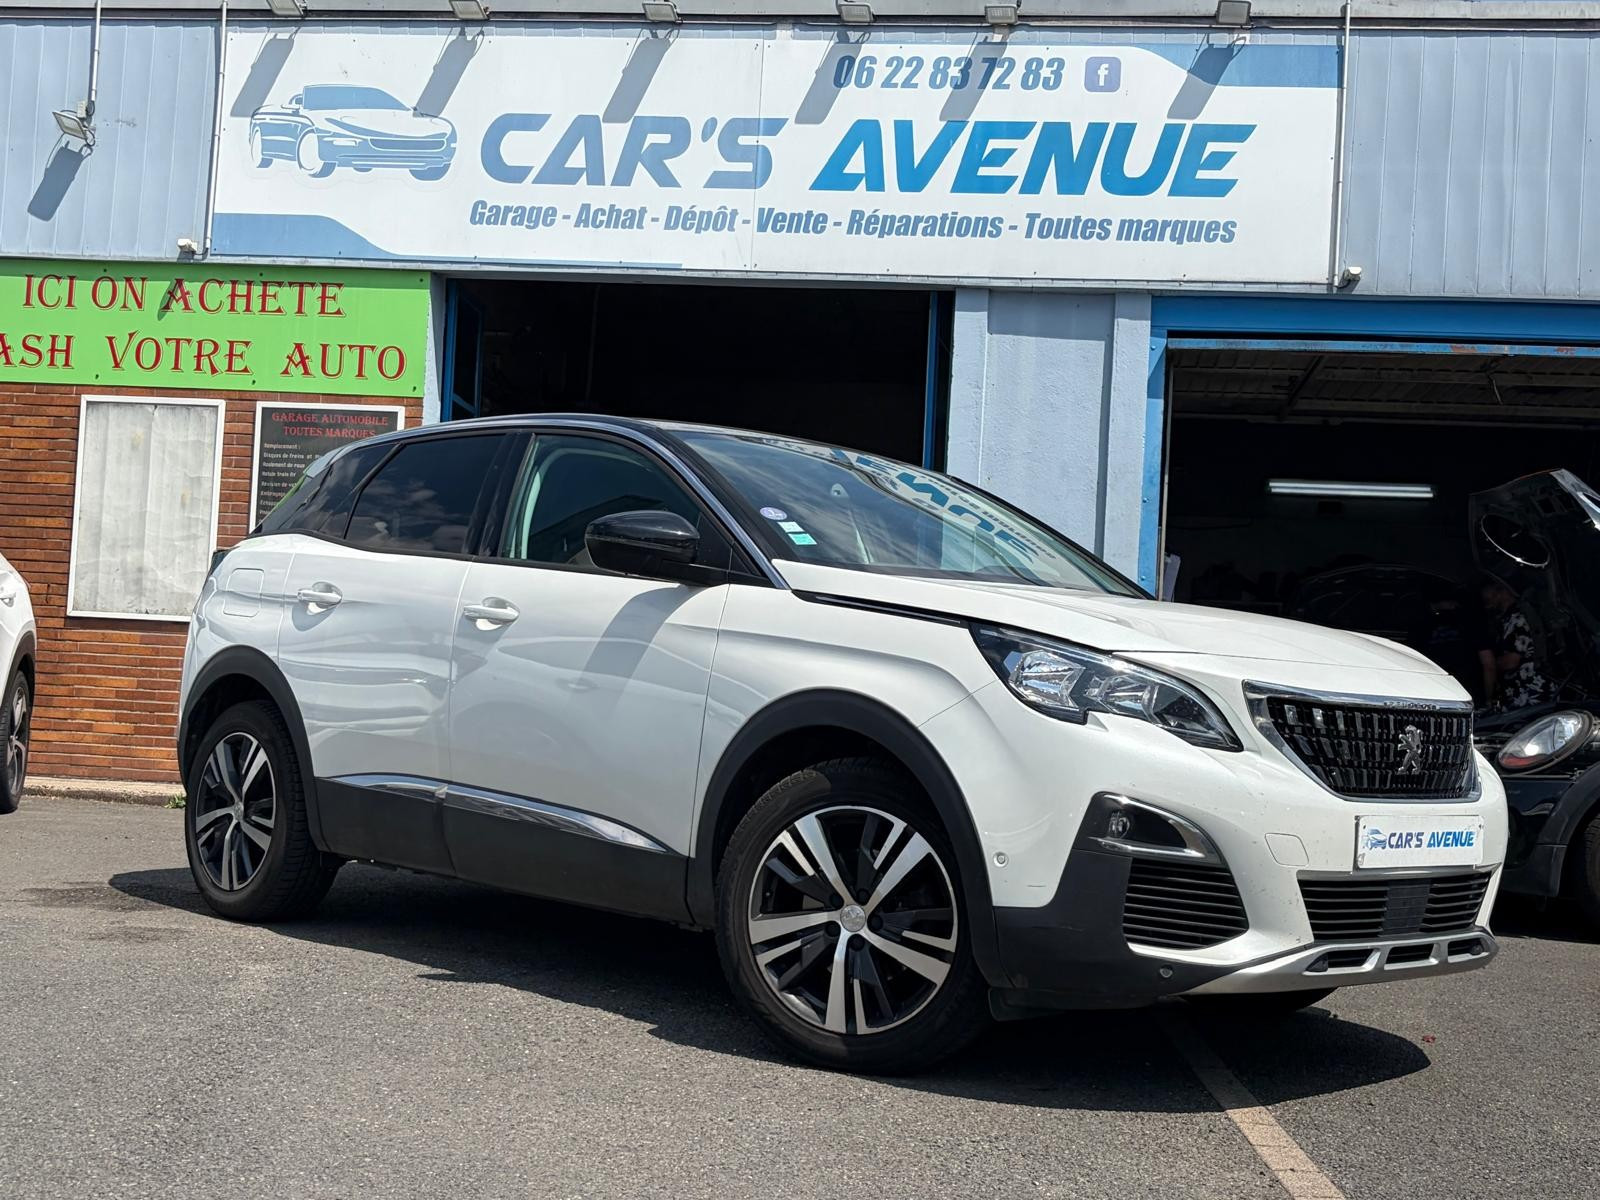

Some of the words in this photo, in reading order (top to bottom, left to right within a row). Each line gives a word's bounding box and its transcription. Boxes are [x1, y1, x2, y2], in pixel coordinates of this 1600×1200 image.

[833, 55, 877, 90] 06
[880, 55, 923, 90] 22
[928, 55, 973, 90] 83
[976, 56, 1016, 91] 72
[1020, 57, 1066, 91] 83
[481, 112, 789, 190] CAR'S
[808, 118, 1258, 198] AVENUE
[470, 199, 557, 228] Garage
[574, 202, 648, 230] Achat
[664, 204, 739, 234] Dépôt
[756, 207, 827, 235] Vente
[847, 209, 1004, 240] Réparations
[1025, 212, 1111, 242] Toutes
[1116, 217, 1238, 246] marques
[23, 273, 77, 309] ICI
[91, 275, 149, 311] ON
[163, 277, 347, 317] ACHETE
[105, 330, 253, 376] VOTRE
[280, 342, 408, 381] AUTO
[272, 412, 319, 423] GARAGE
[321, 413, 389, 426] AUTOMOBILE
[283, 426, 323, 437] TOUTES
[325, 428, 376, 439] MARQUES
[1388, 831, 1423, 849] CAR'S
[1426, 830, 1475, 849] AVENUE
